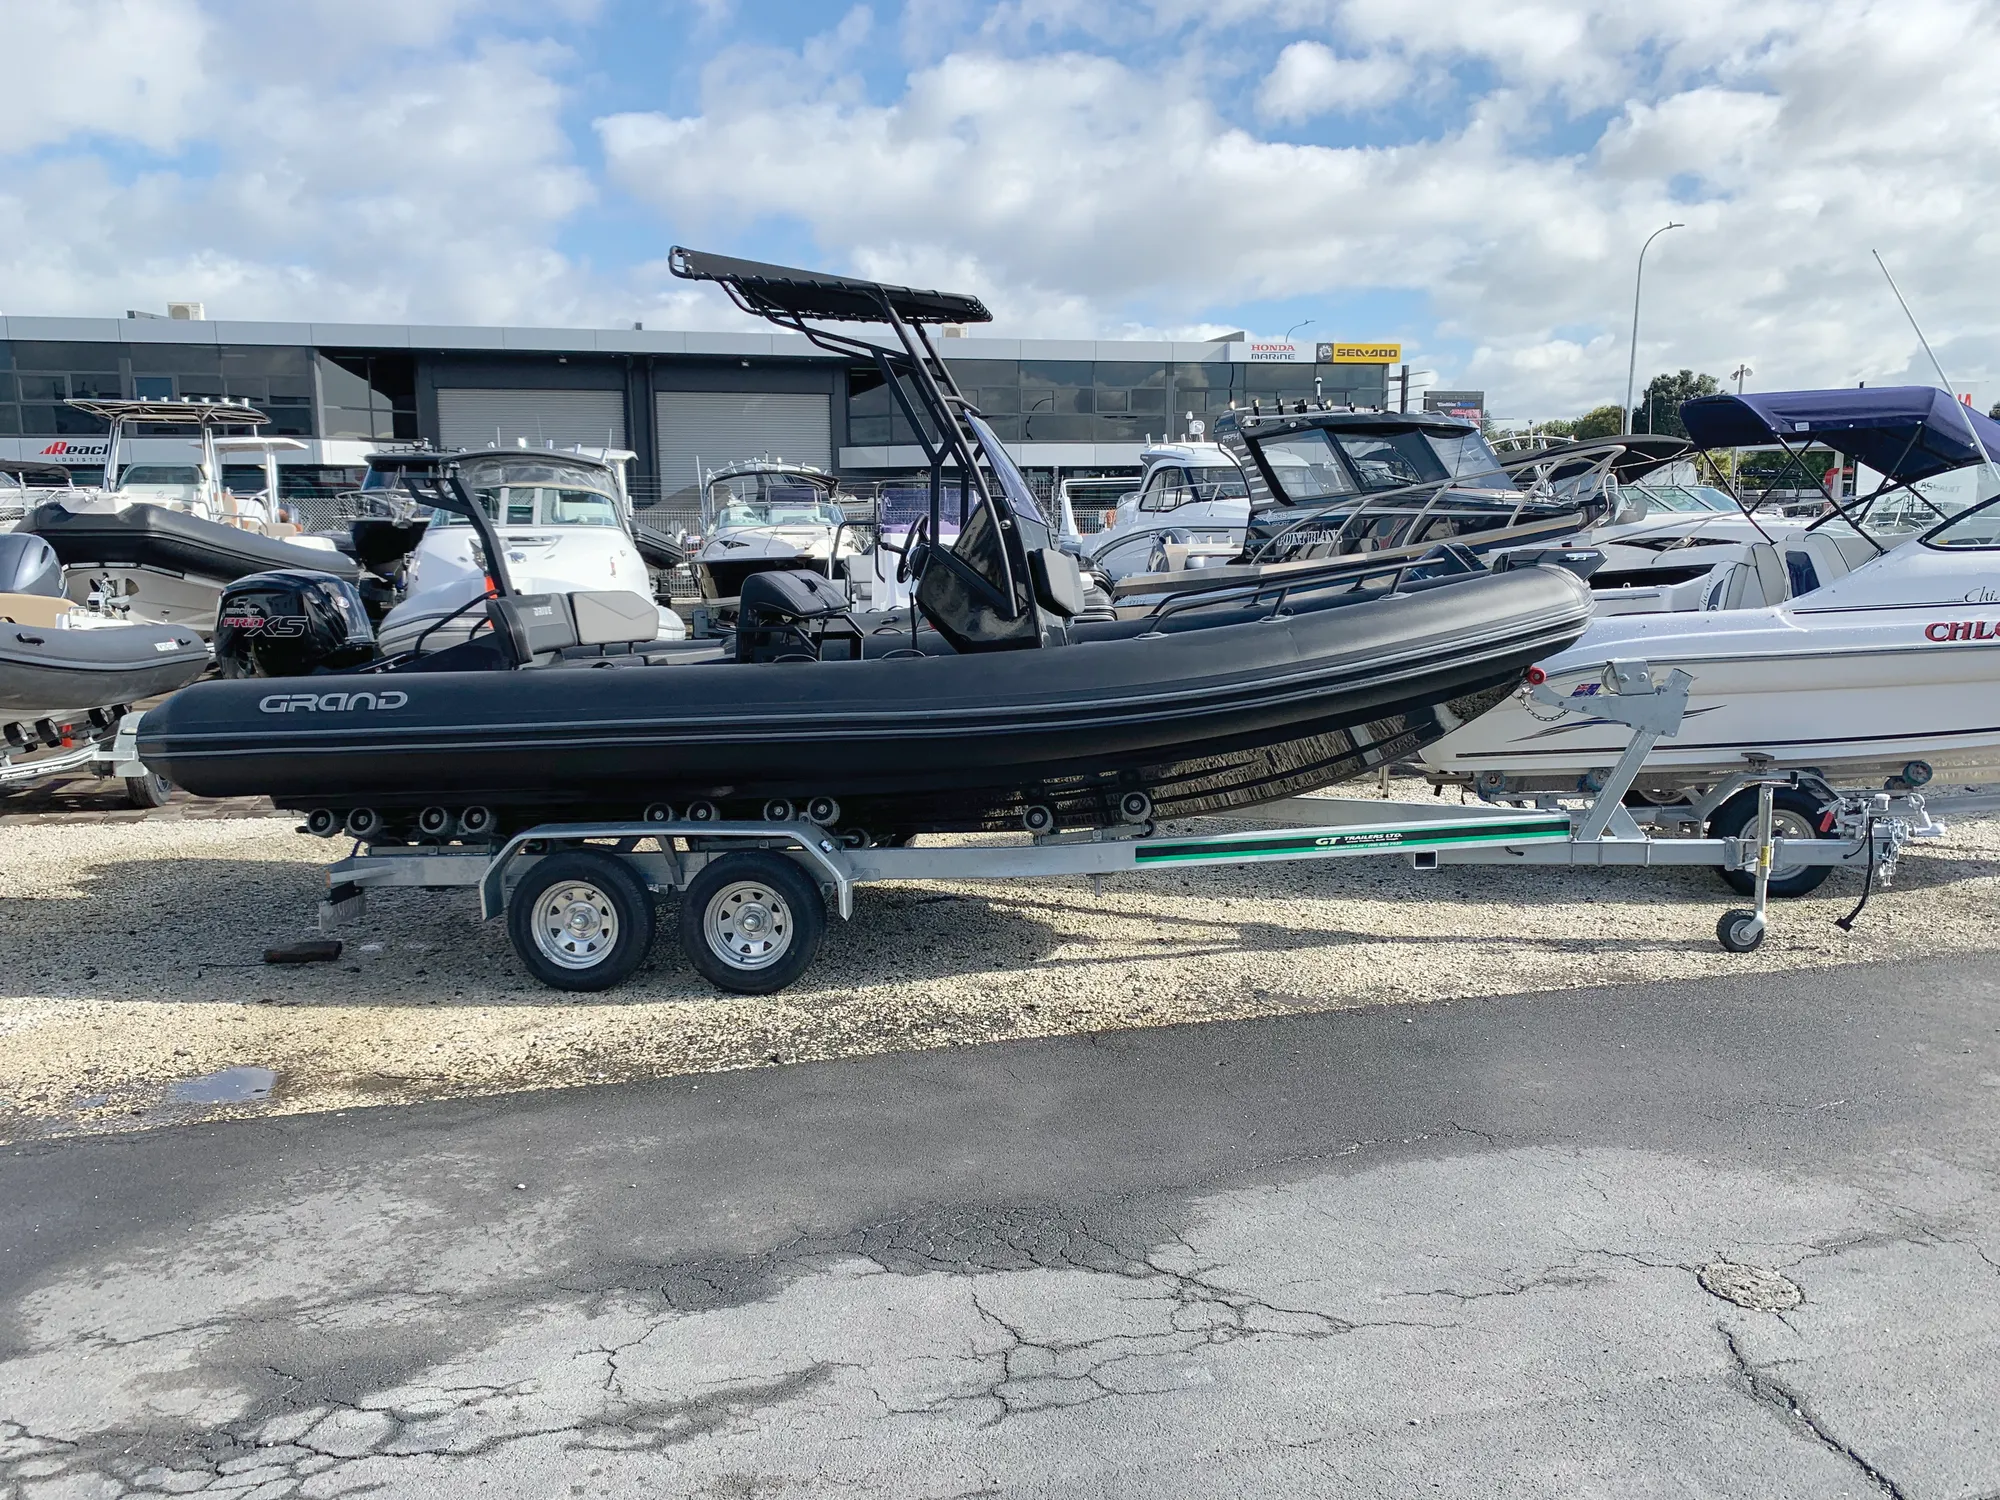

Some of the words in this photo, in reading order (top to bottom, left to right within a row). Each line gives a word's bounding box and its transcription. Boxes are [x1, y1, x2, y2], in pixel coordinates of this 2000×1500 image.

[1307, 529, 1343, 545] BLAN
[243, 615, 309, 637] XS
[259, 691, 409, 713] GRAND
[1315, 837, 1341, 846] GT
